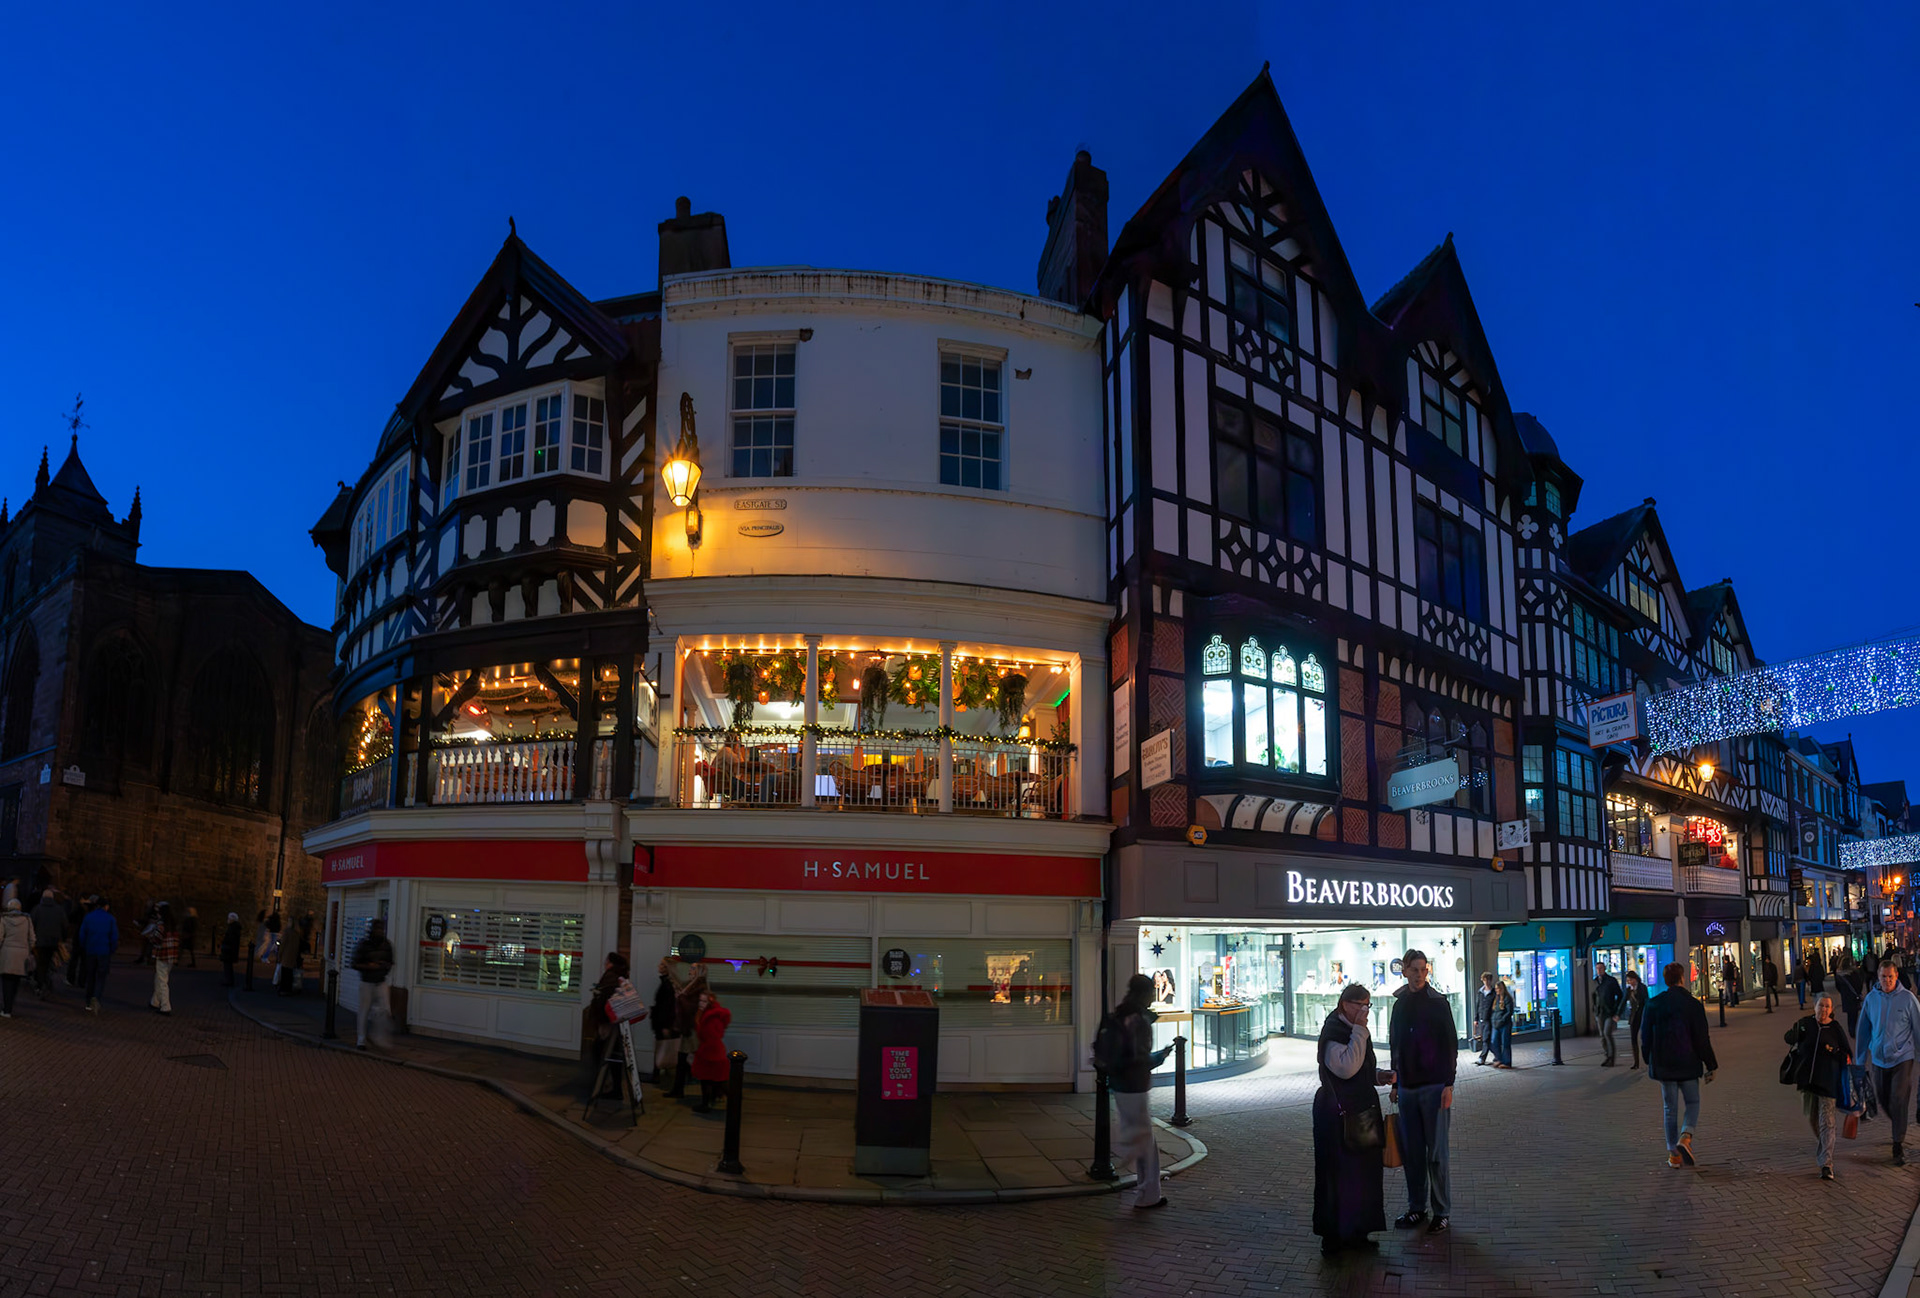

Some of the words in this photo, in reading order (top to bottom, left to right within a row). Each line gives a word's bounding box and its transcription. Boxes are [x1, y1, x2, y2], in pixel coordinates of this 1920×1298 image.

[736, 501, 771, 509] EASTGATE
[1391, 773, 1455, 798] BEAVERBROOKS
[1286, 870, 1455, 908] BEAVERBROOKS
